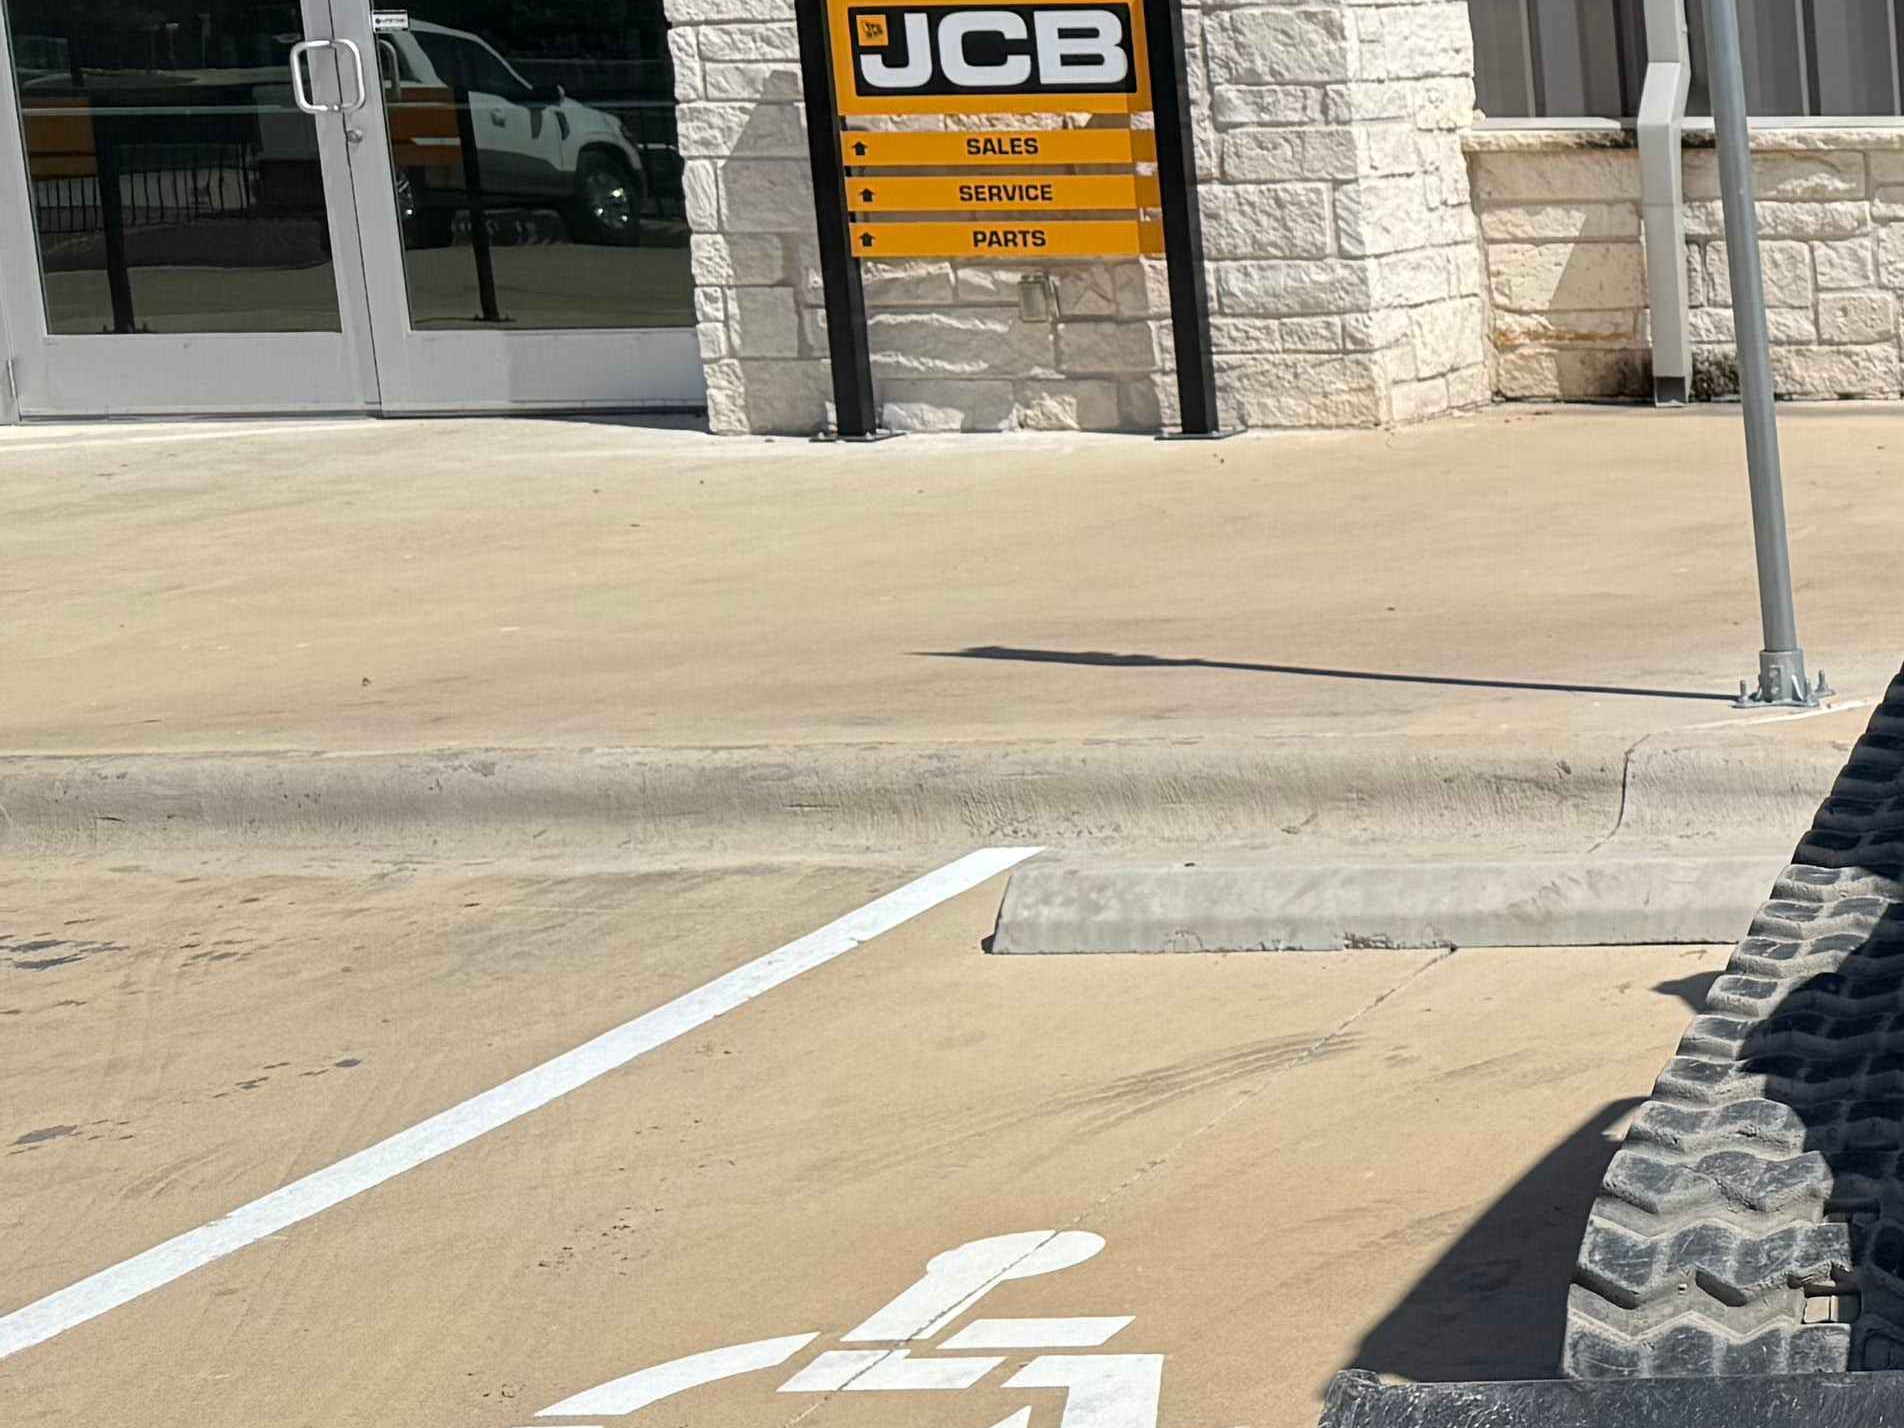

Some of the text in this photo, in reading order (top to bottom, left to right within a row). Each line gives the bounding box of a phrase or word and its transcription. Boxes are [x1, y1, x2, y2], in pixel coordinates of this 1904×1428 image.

[859, 10, 1129, 88] JCB
[966, 137, 1039, 156] SALES
[959, 183, 1053, 203] SERVICE
[973, 229, 1047, 249] PARTS
